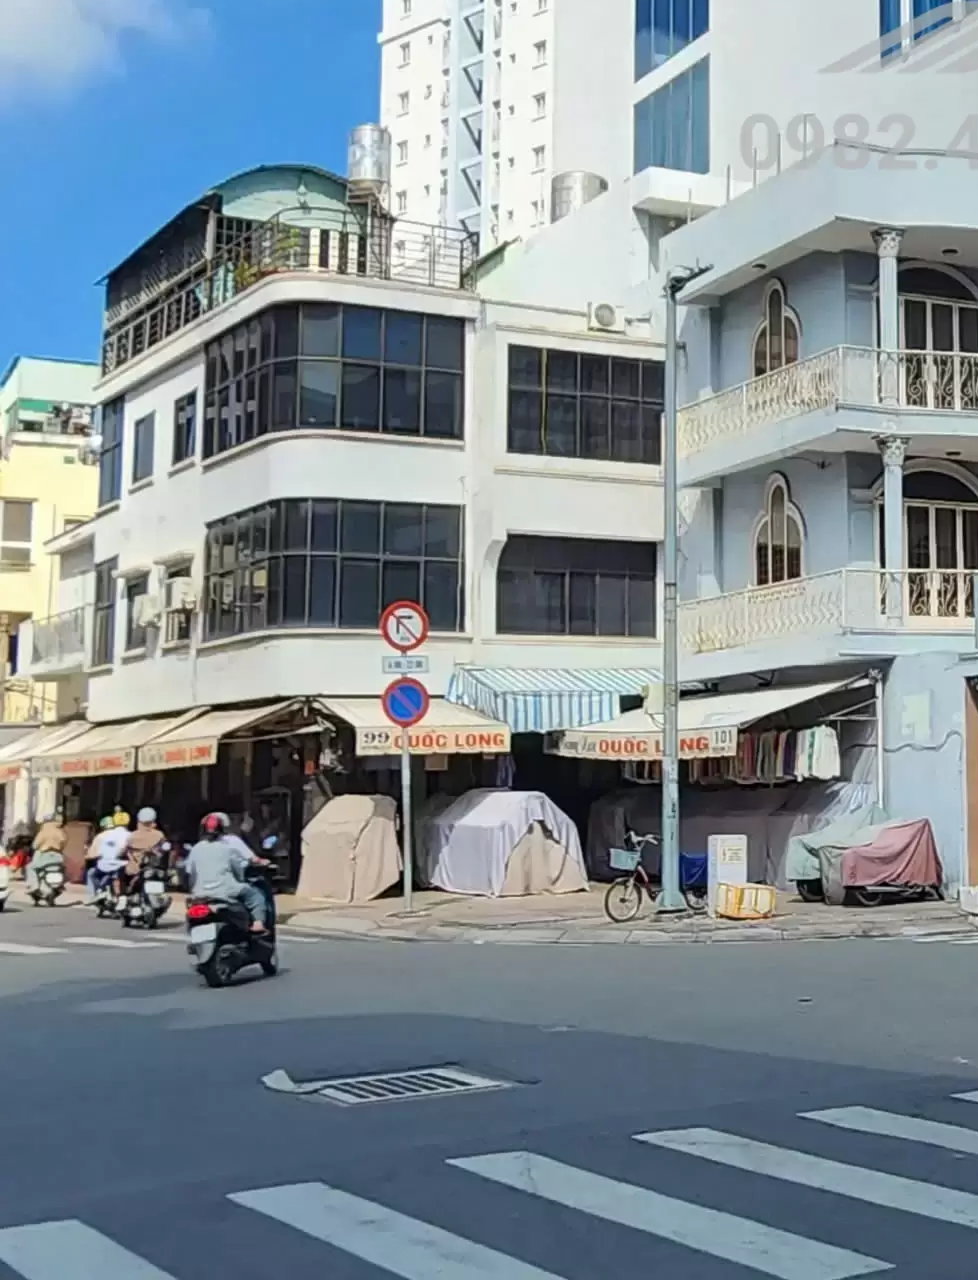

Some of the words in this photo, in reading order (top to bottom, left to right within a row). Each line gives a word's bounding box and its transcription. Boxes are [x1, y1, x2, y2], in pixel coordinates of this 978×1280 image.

[363, 731, 390, 745] 99
[455, 732, 505, 748] LONG
[654, 736, 709, 754] LNG
